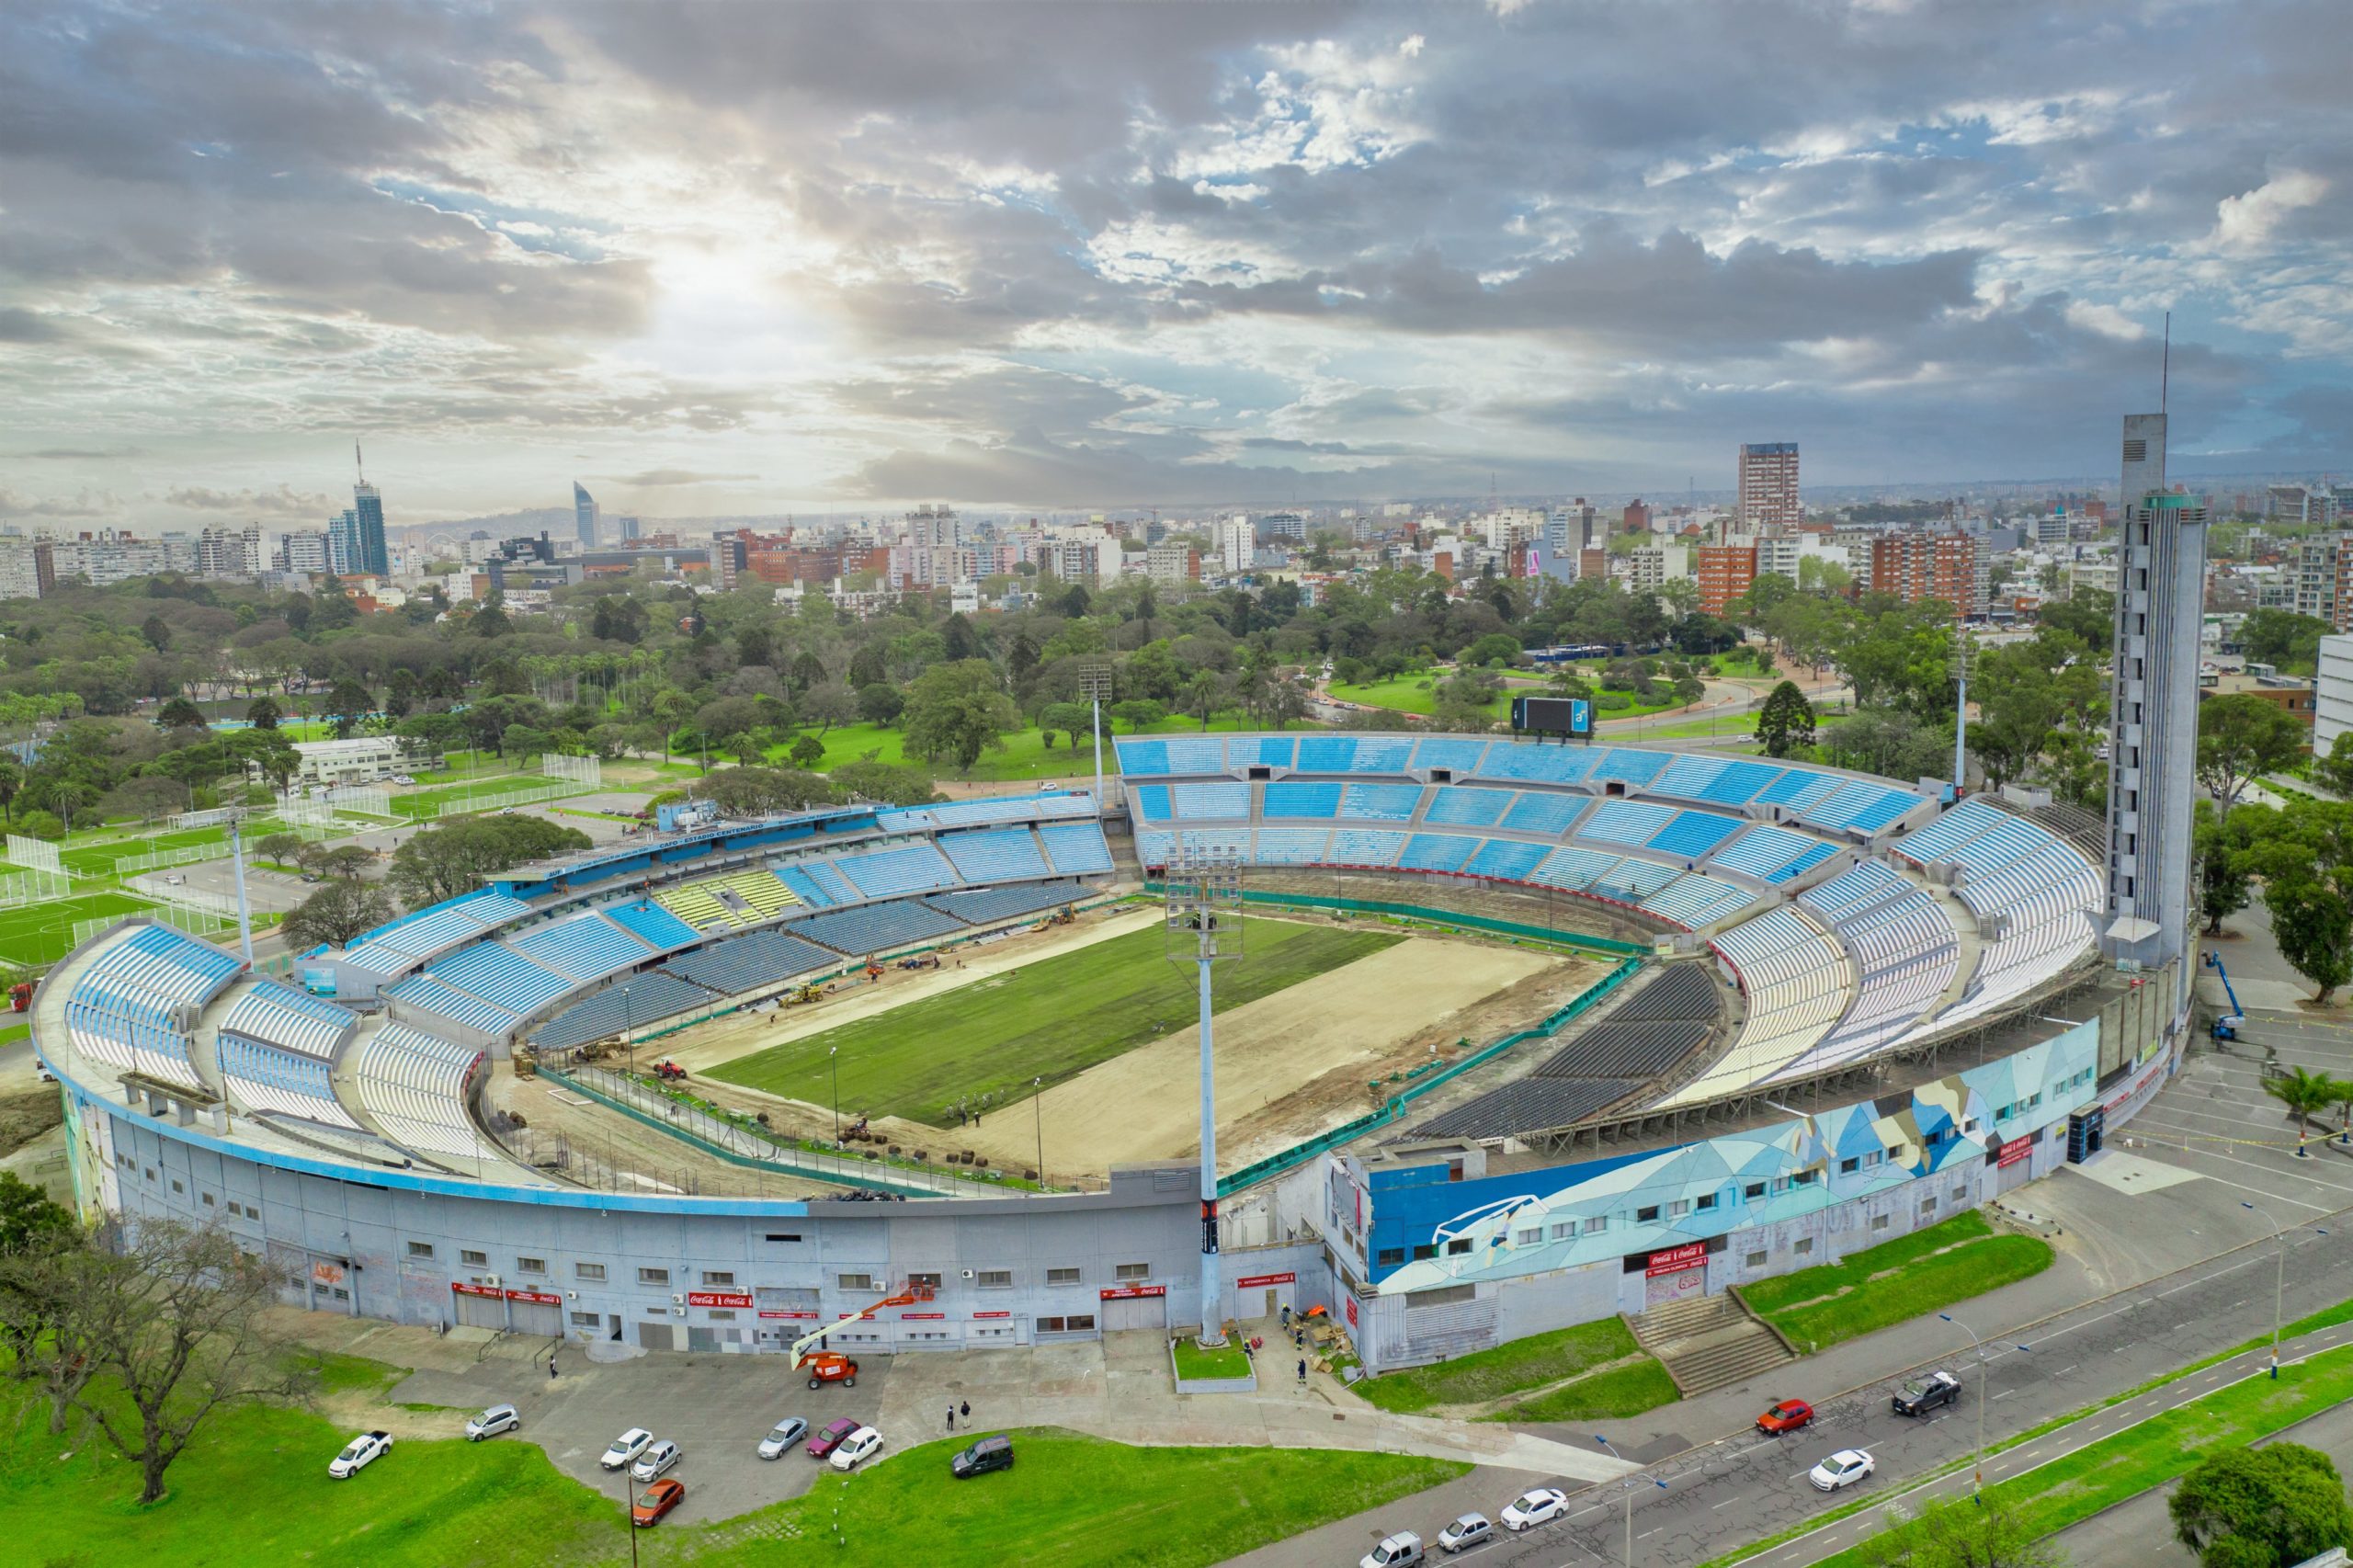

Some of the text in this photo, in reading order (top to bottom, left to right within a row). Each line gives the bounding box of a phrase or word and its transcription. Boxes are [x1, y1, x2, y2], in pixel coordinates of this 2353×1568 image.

[659, 840, 678, 848] CAFO
[685, 833, 715, 842] ESTADIO
[717, 824, 764, 835] CENTENARIO
[1652, 1248, 1697, 1265] Coca-Cola Coca-Cola
[690, 1294, 746, 1306] Coca-Cola Coca-Cola
